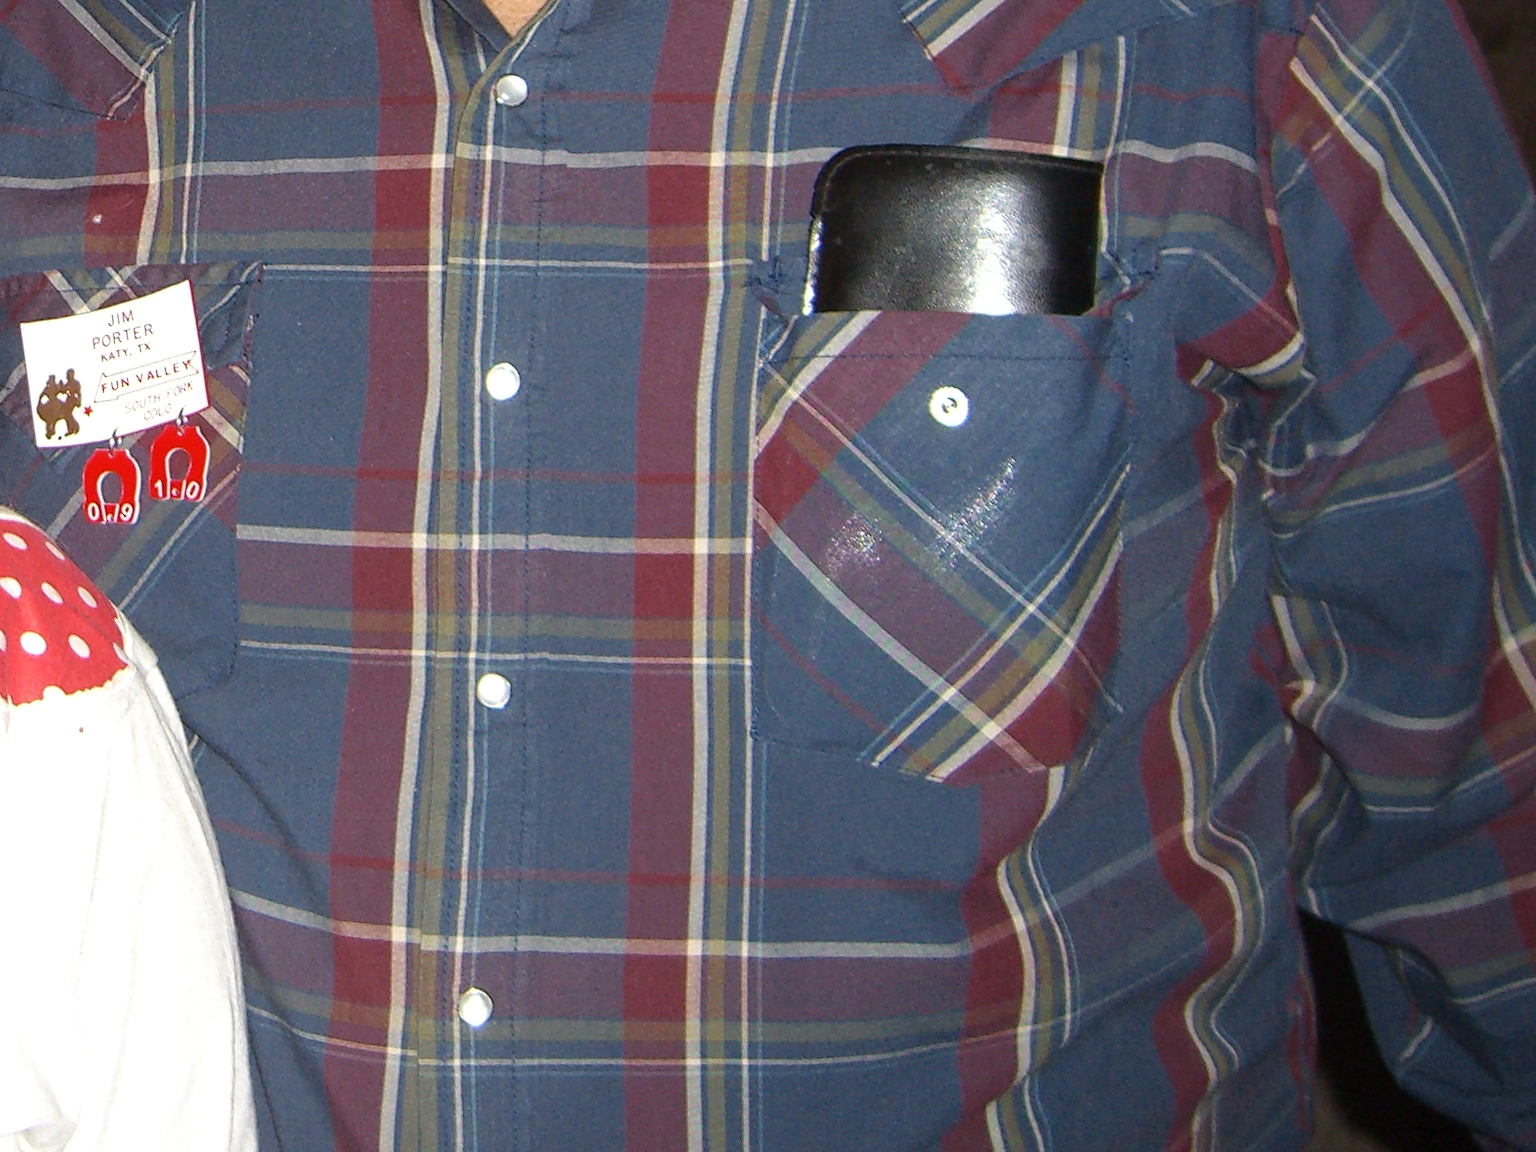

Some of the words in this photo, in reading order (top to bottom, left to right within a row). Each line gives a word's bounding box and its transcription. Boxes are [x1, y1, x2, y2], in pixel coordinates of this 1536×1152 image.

[107, 309, 135, 328] JIM
[92, 323, 154, 349] PORTER
[138, 341, 152, 353] TX
[100, 376, 130, 394] FUN
[135, 360, 192, 384] VALLEY
